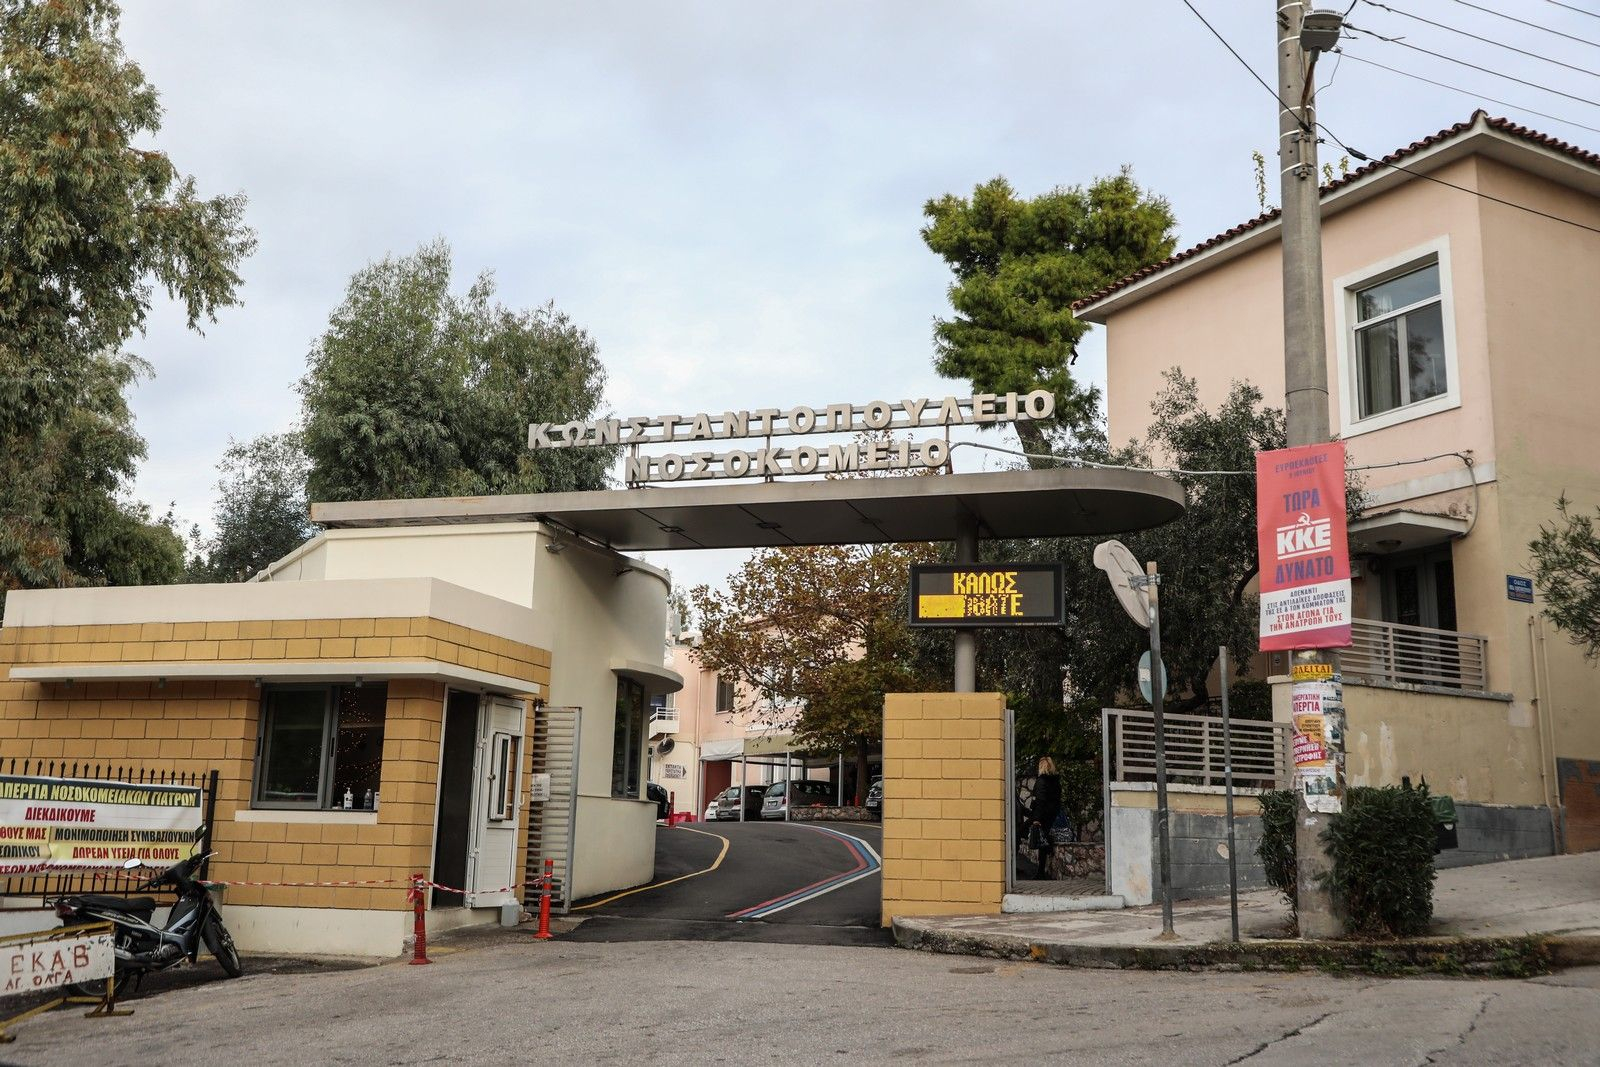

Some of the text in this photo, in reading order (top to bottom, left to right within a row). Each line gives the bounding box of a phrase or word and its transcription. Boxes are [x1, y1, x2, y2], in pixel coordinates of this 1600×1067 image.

[528, 390, 1055, 450] ΚΩΝΣΤΑΝΤΟΠΟΥΛΕΙΟ
[625, 438, 949, 482] ΝΟΣΟΚΟΜΕΙΟ
[1283, 488, 1320, 512] ΤΩΡΑ
[1276, 524, 1331, 555] ΚΚΕ
[1275, 556, 1334, 584] ΔΥΝΑΤΟ
[1290, 587, 1318, 597] ΑΠΕΝΑΝΤΙ
[1270, 623, 1283, 632] ΤΗΝ
[1325, 613, 1343, 623] ΤΟΥΣ
[1277, 606, 1334, 622] ΣΤΟΝ ΑΓΩΝΑ ΓΙΑ
[51, 785, 151, 805] ΝΟΣΟΚΟΜΕΙΑΚΩΝ
[150, 791, 196, 807] ΓΙΑΤΡΩΝ
[25, 807, 96, 823] ΔΙΕΚΔΙΚΟΥΜΕ
[26, 828, 47, 840] ΜΑΣ
[55, 828, 195, 843] ΜΟΝΙΜΟΠΟΙΗΣΗ ΣΥΜΒΑΣΙΟΥΧΩΝ
[73, 847, 179, 860] ΔΩΡΕΑΝ ΥΓΕΙΑ ΓΙΑ ΟΛΟΥΣ
[11, 944, 89, 975] ΕΚΑΒ
